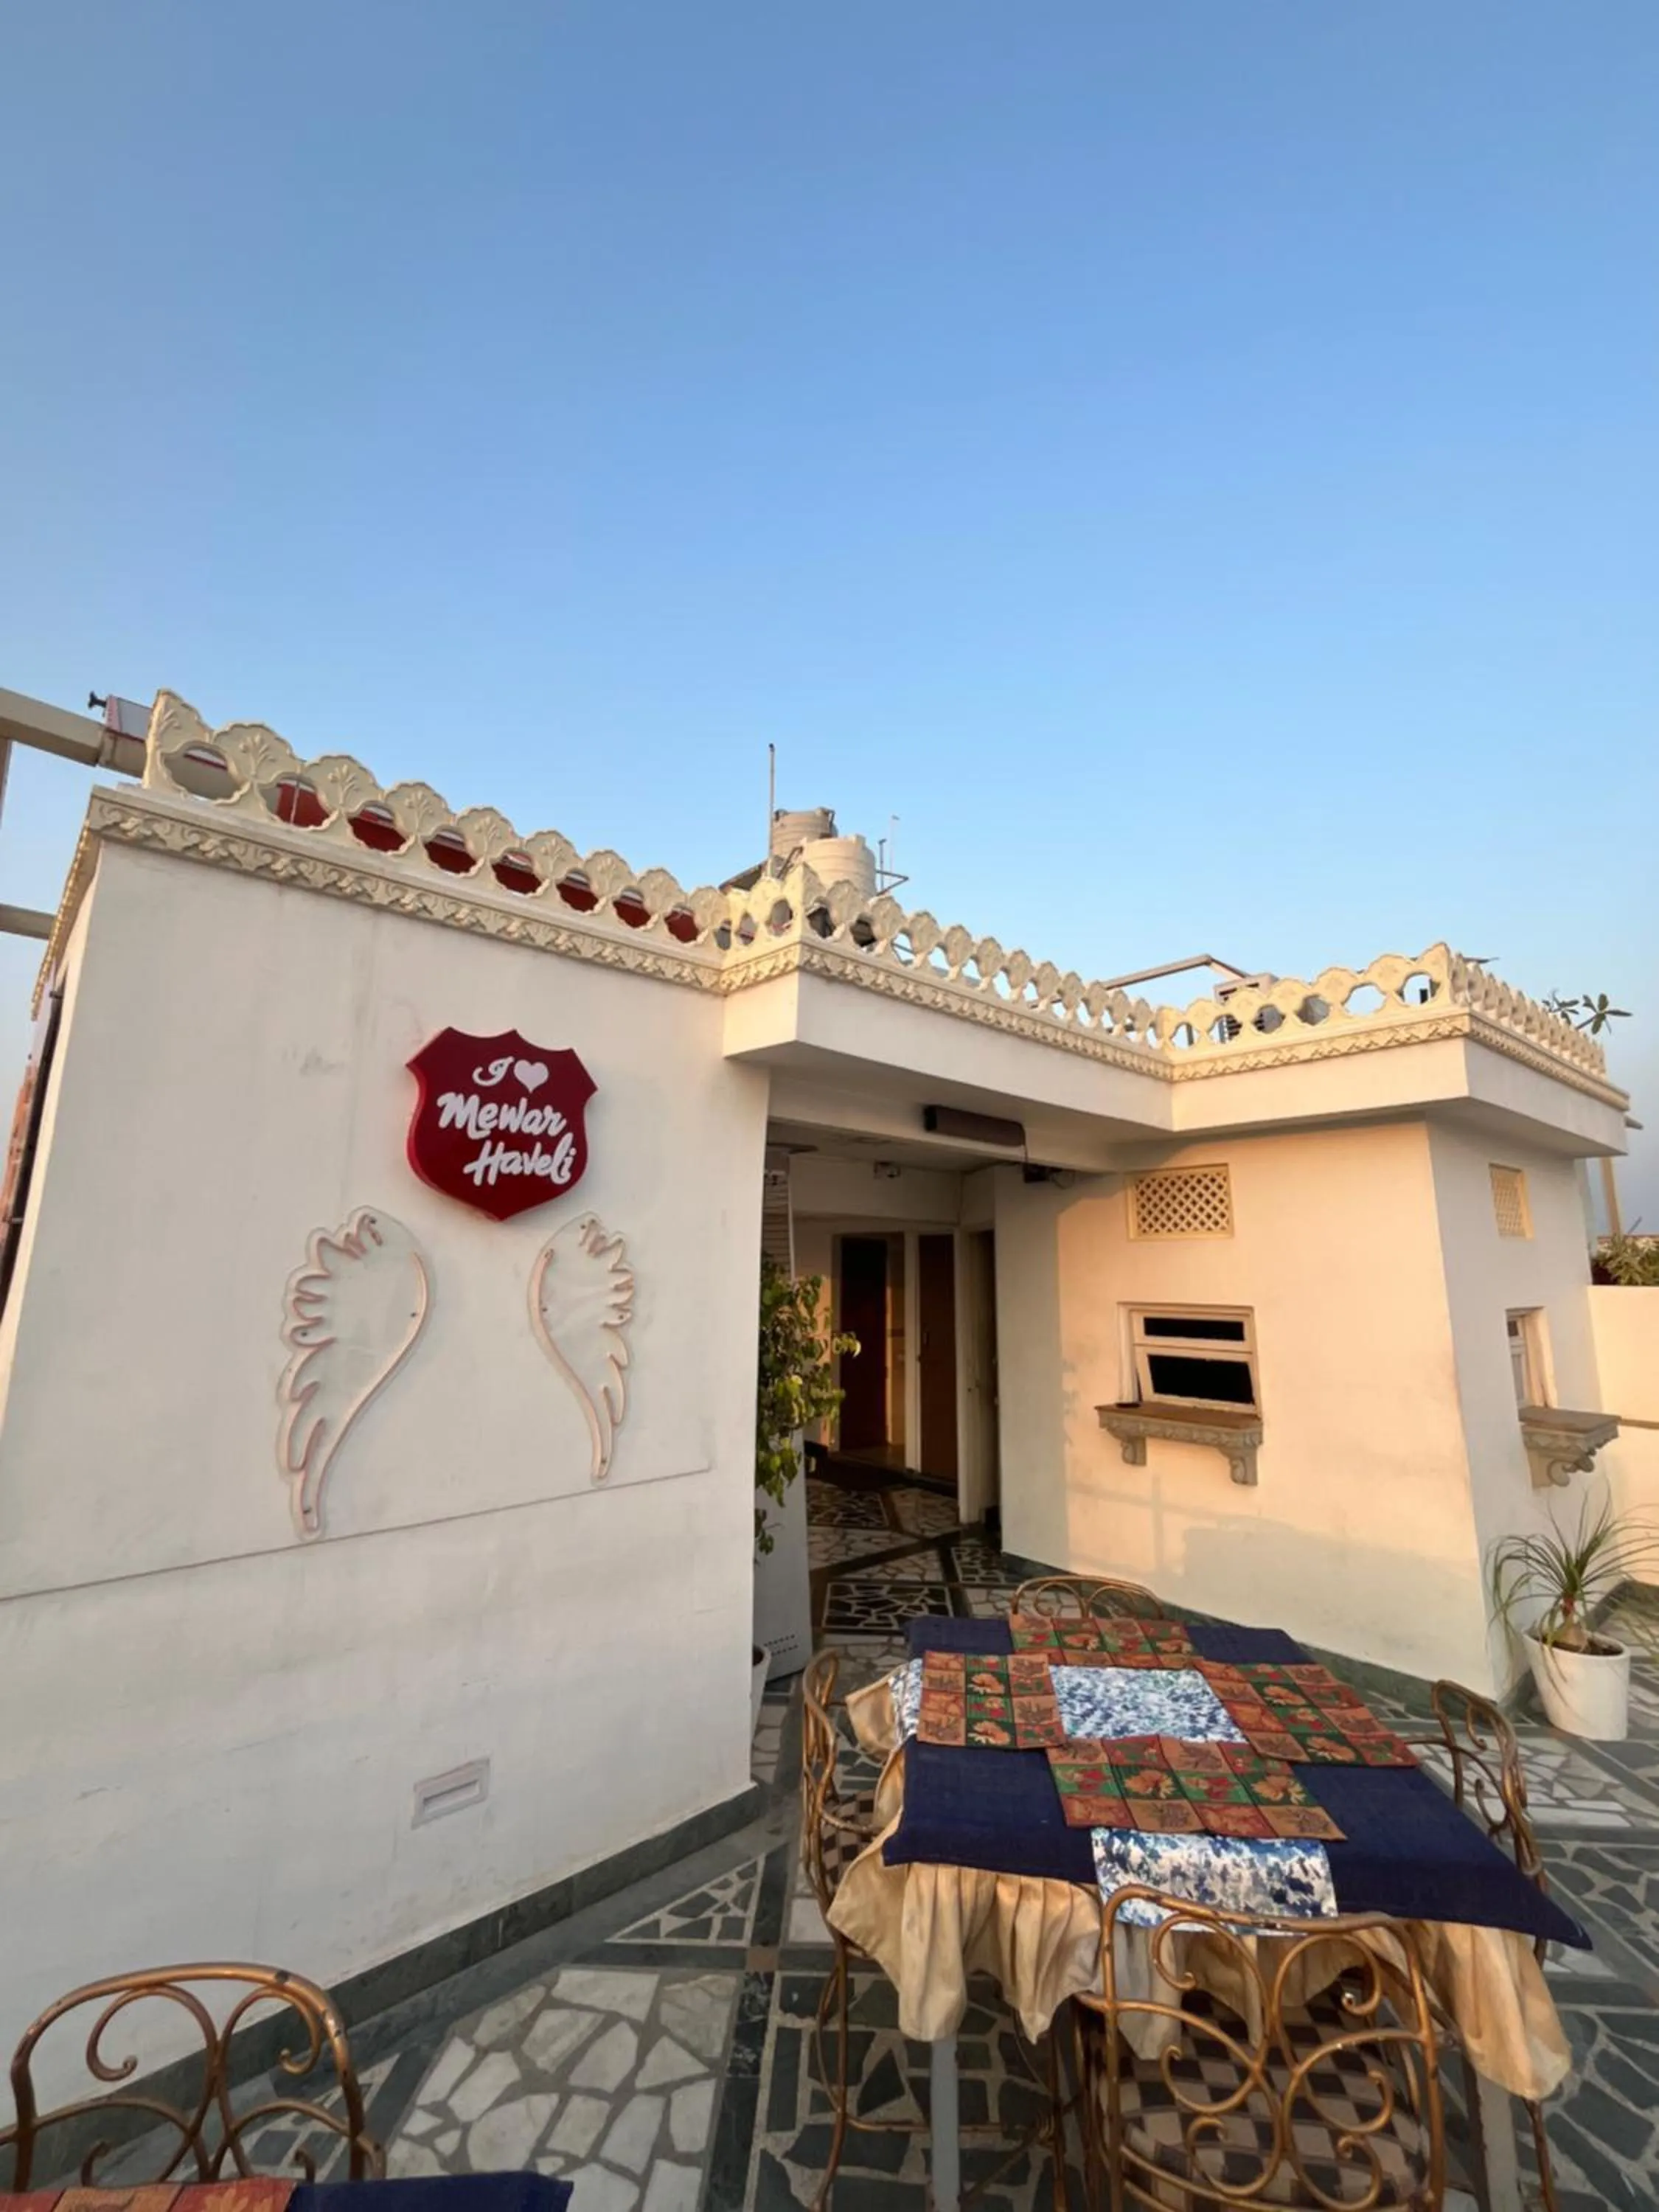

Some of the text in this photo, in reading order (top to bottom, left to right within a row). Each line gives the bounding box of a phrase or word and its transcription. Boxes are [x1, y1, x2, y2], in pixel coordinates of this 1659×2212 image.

[472, 1056, 515, 1087] I
[436, 1092, 567, 1140] Mewar
[462, 1132, 577, 1186] Haveli
